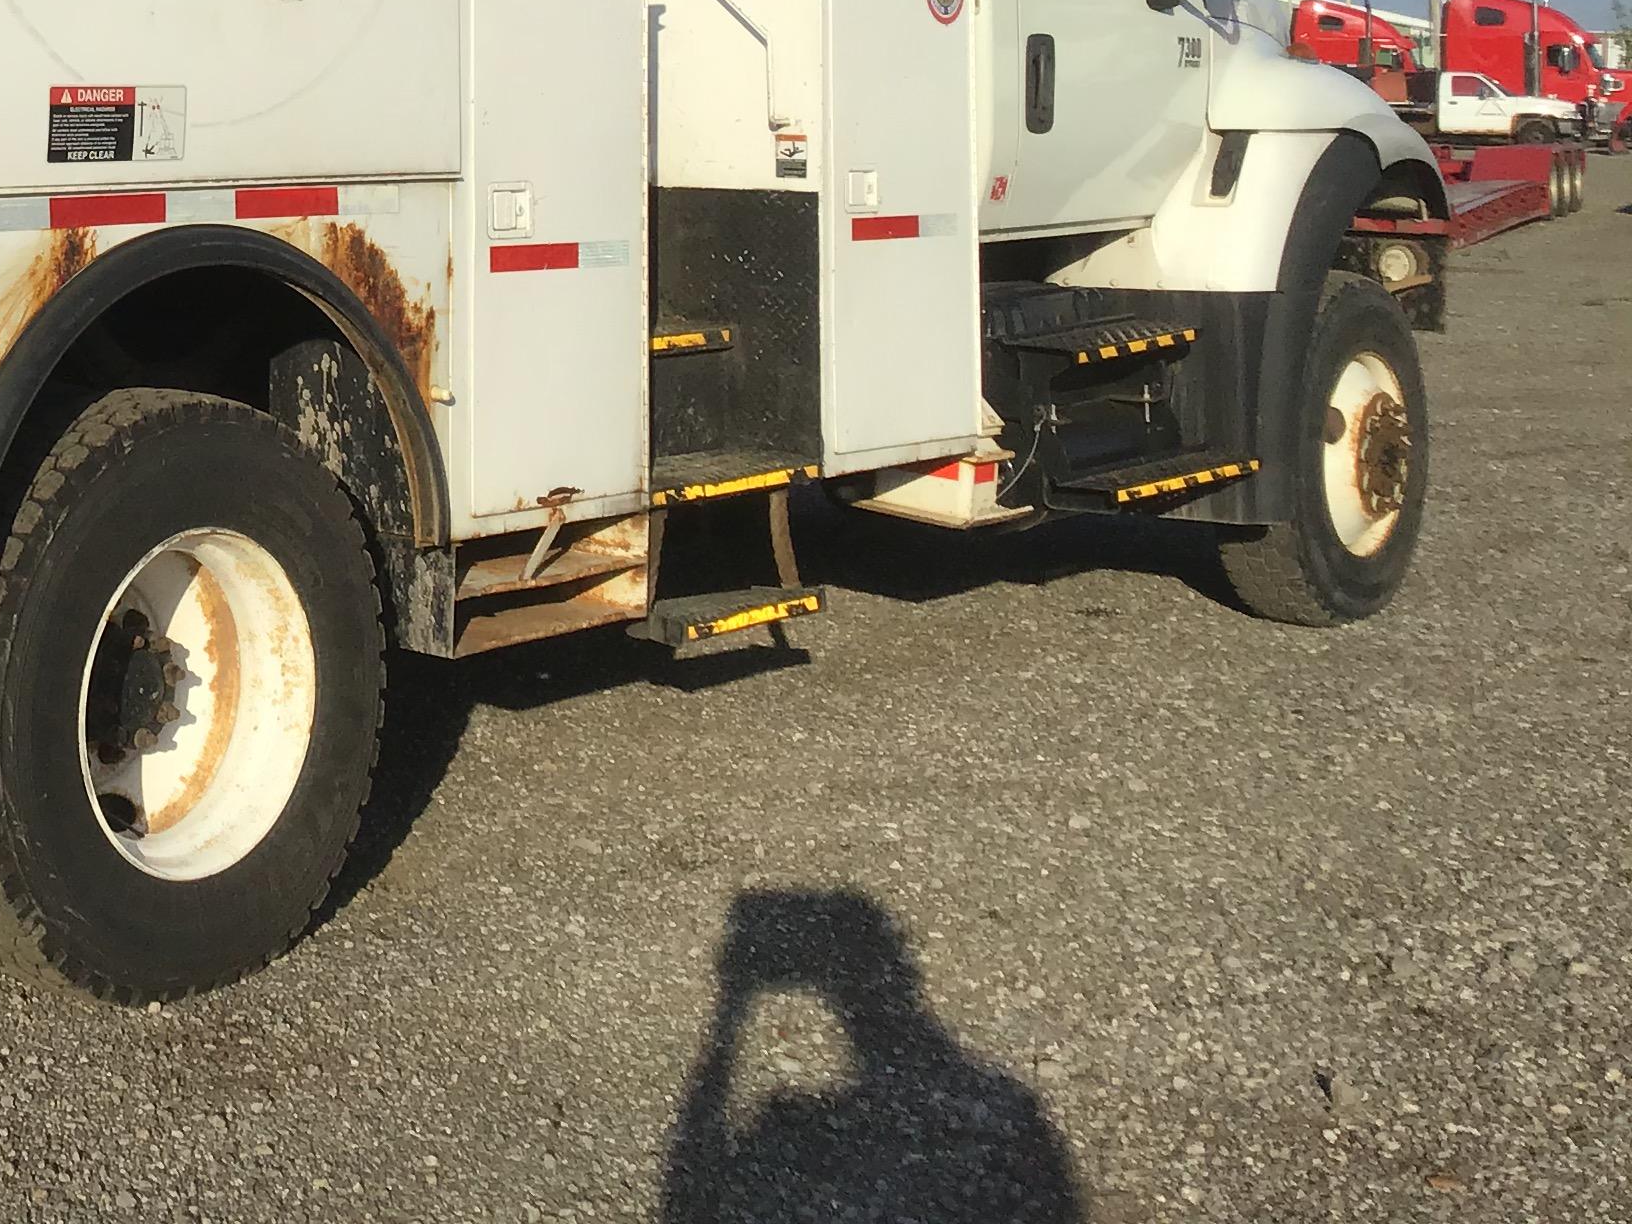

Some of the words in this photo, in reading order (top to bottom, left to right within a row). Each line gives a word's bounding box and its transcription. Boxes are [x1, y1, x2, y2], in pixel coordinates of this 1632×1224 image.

[77, 88, 124, 103] DANGER
[67, 151, 89, 161] KEEP
[88, 150, 115, 160] CLEAR
